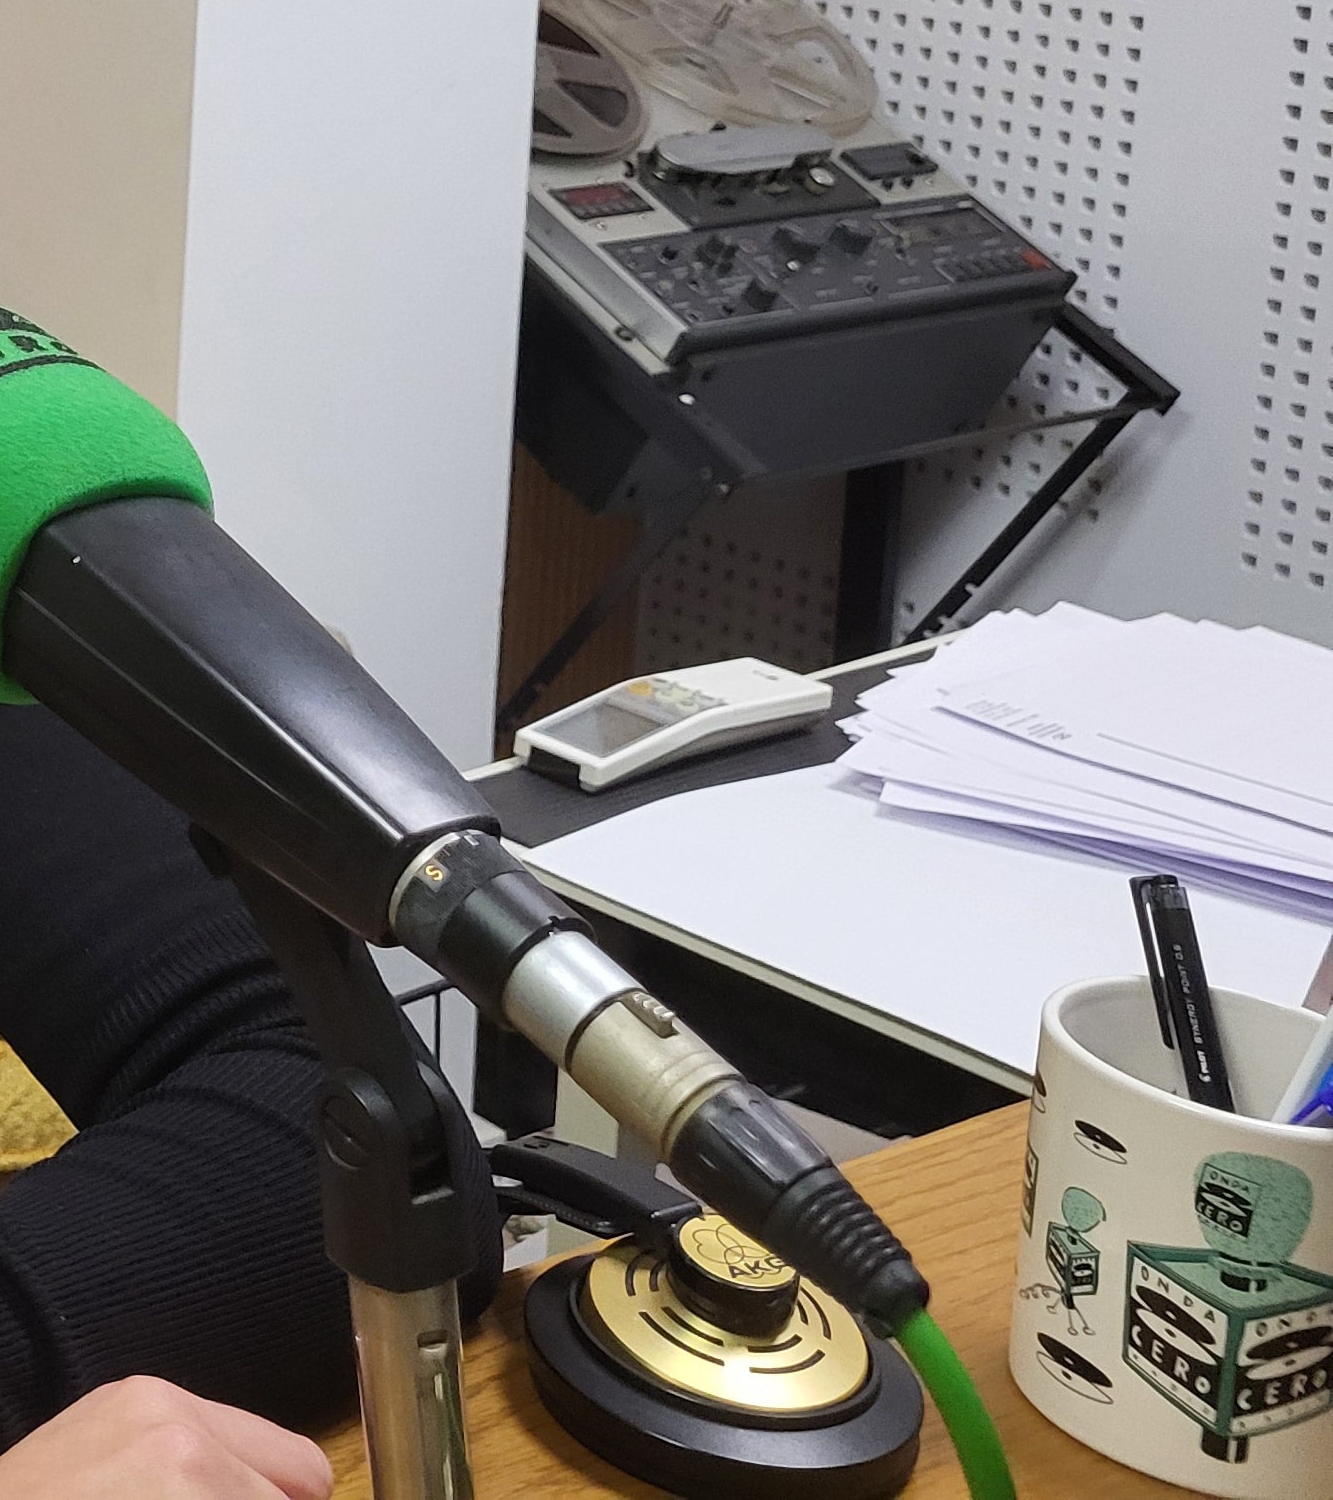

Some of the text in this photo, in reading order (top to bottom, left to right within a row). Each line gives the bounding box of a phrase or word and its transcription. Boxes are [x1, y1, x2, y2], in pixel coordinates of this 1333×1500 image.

[1196, 1202, 1243, 1232] CERO
[729, 1256, 786, 1278] AKG
[1140, 1265, 1216, 1324] ONDA
[1132, 1324, 1212, 1395] CERO
[1236, 1369, 1328, 1411] CERO
